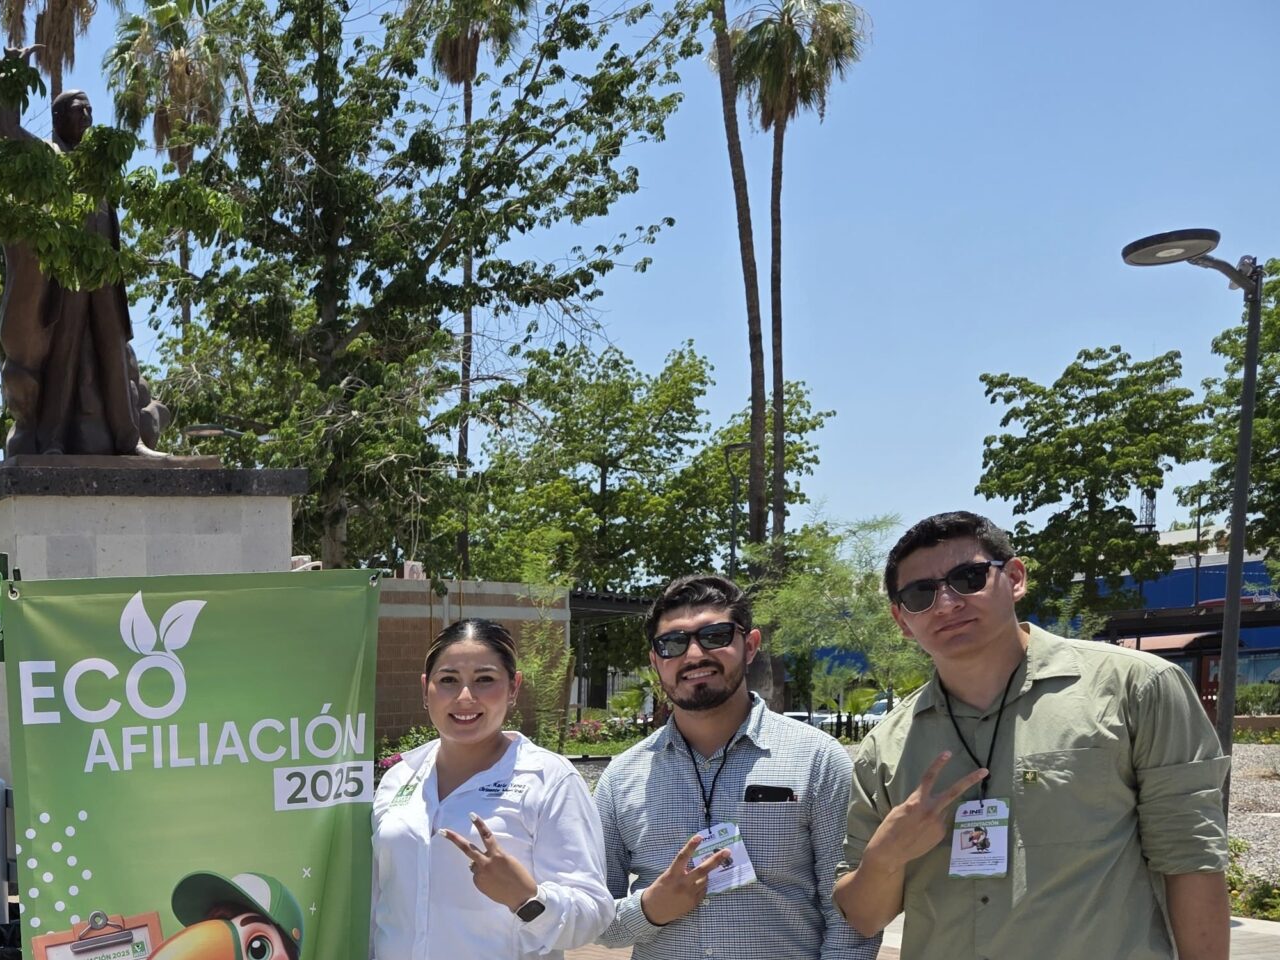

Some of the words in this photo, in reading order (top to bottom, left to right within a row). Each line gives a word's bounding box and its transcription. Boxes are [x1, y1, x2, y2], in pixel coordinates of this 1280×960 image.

[19, 654, 187, 725] ECO
[84, 703, 365, 773] AFILIACIÓN
[285, 765, 365, 804] 2025
[113, 950, 130, 960] 2025
